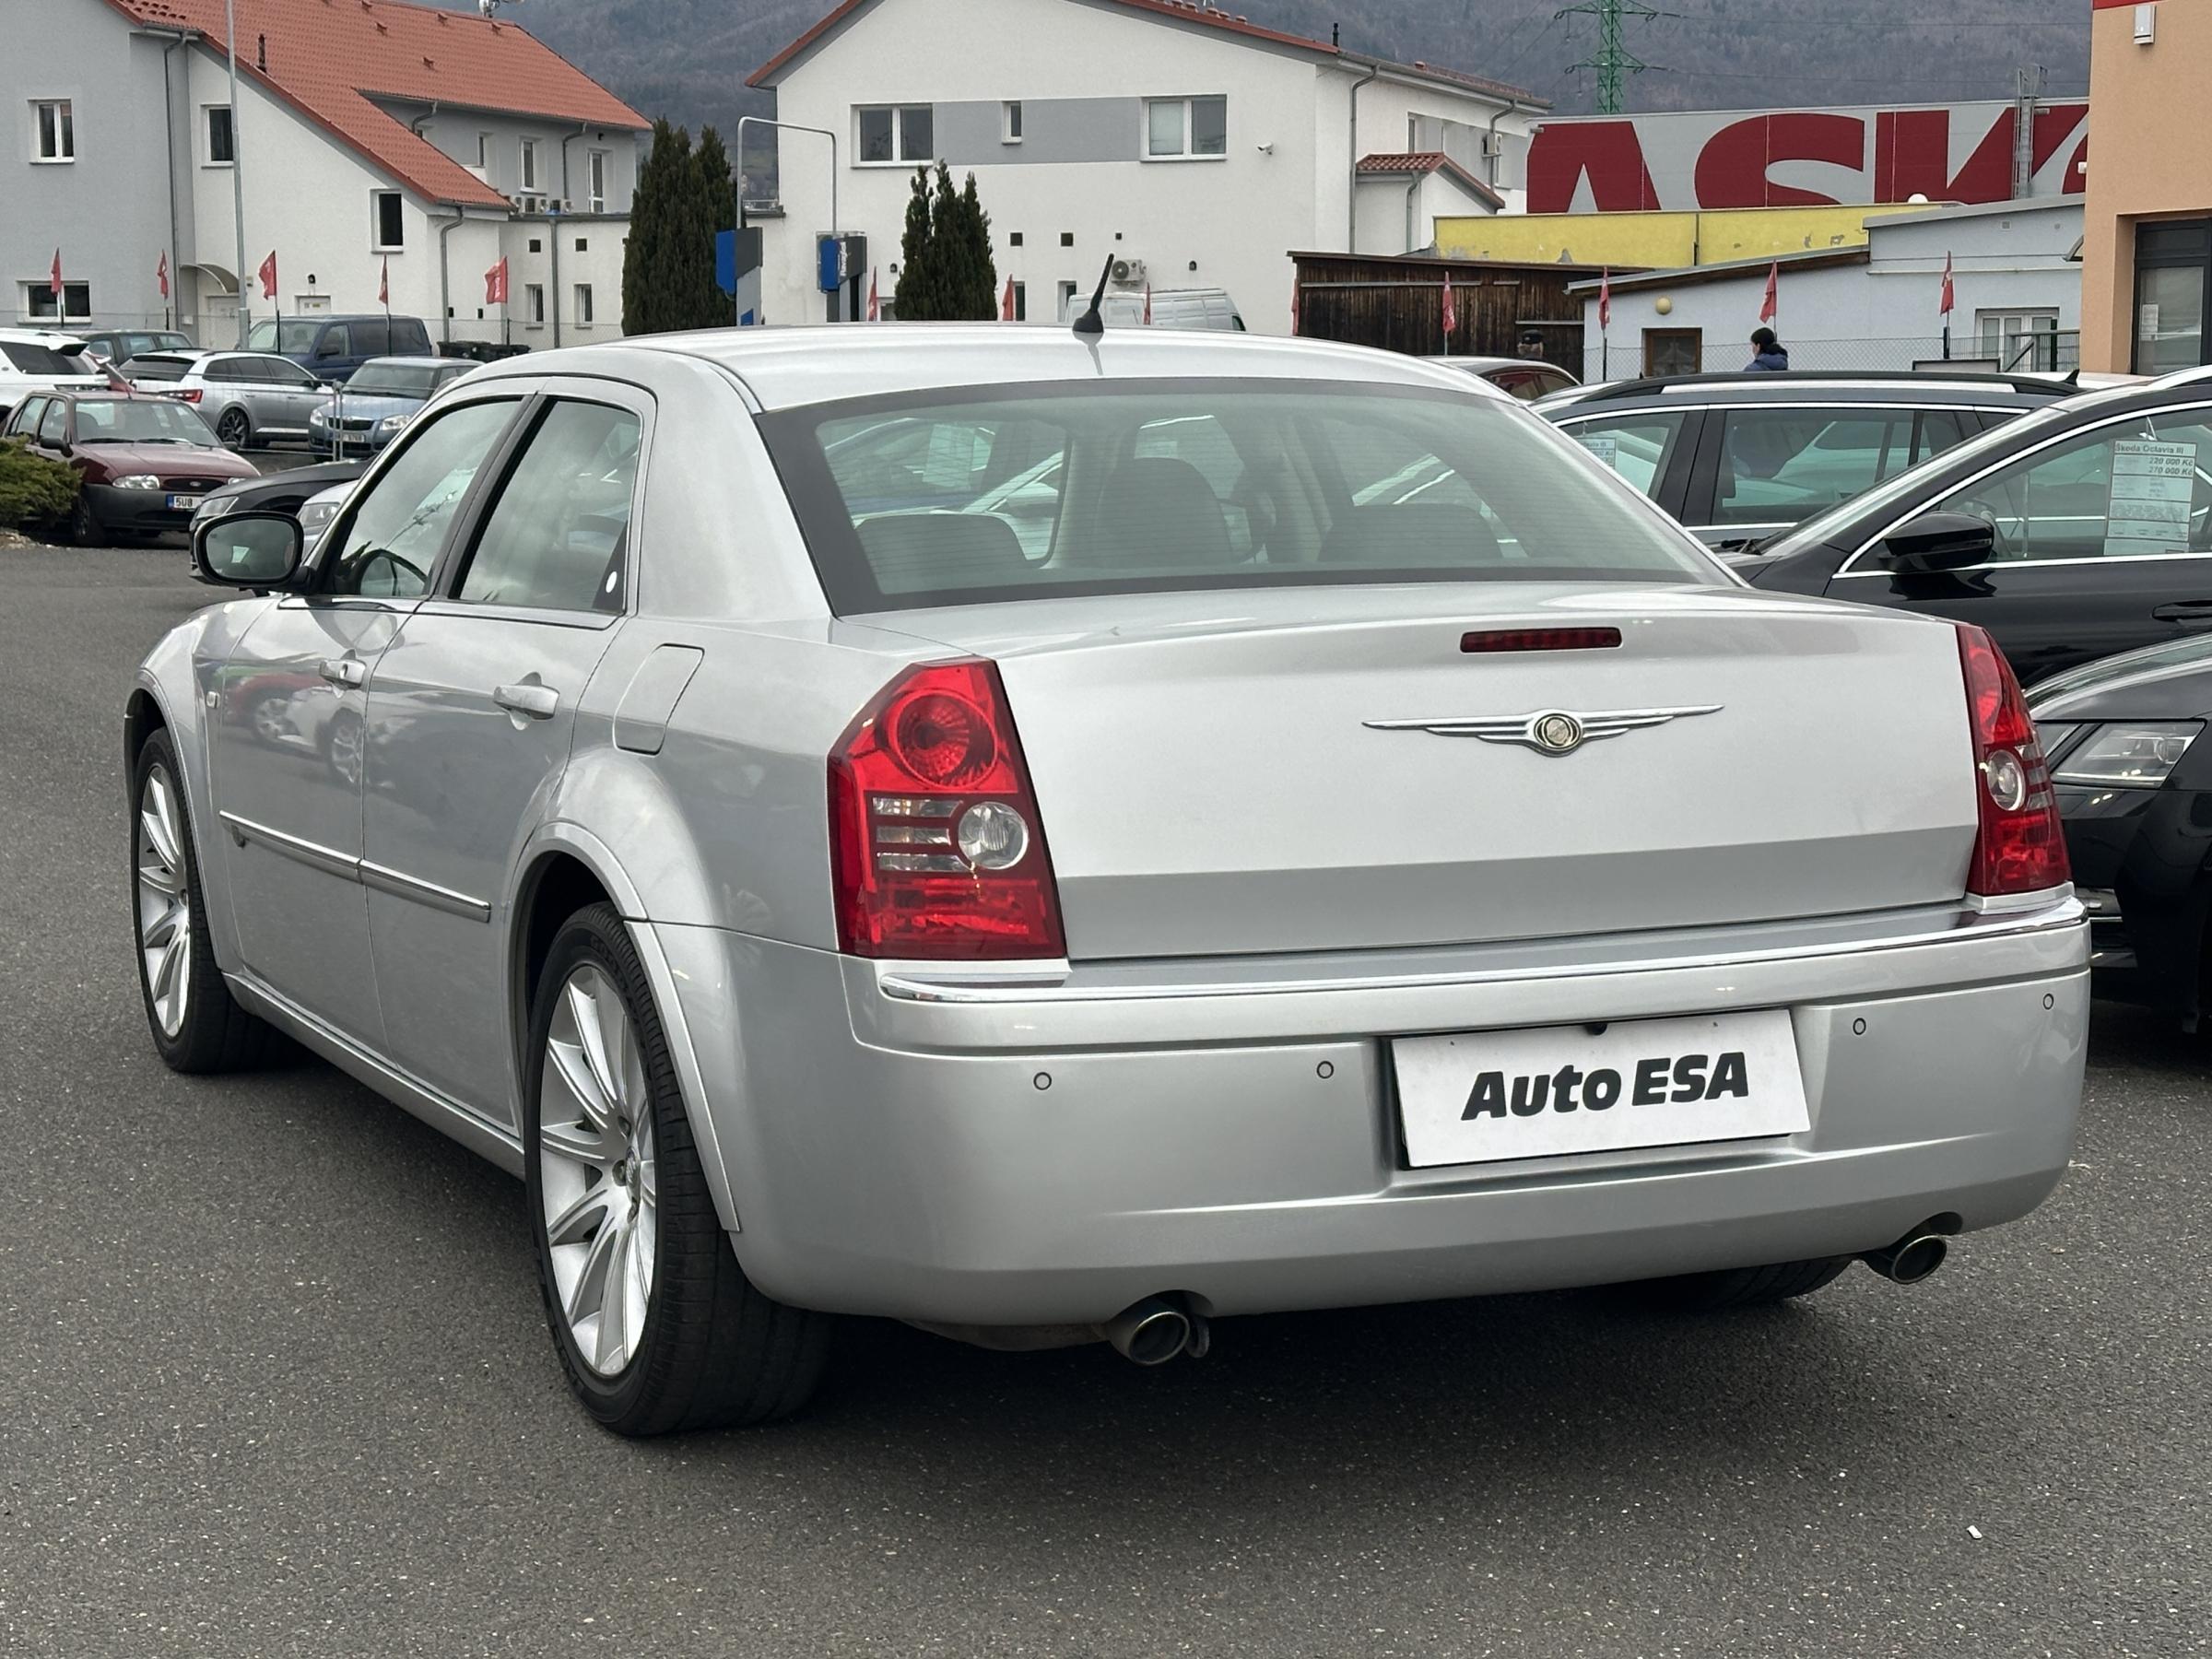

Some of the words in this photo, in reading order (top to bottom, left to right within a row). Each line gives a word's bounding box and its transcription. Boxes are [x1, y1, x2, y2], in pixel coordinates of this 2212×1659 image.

[1527, 103, 2088, 214] ASK
[2143, 444, 2174, 453] Octavia
[1461, 1065, 1622, 1122] Auto
[1631, 1052, 1749, 1107] ESA
